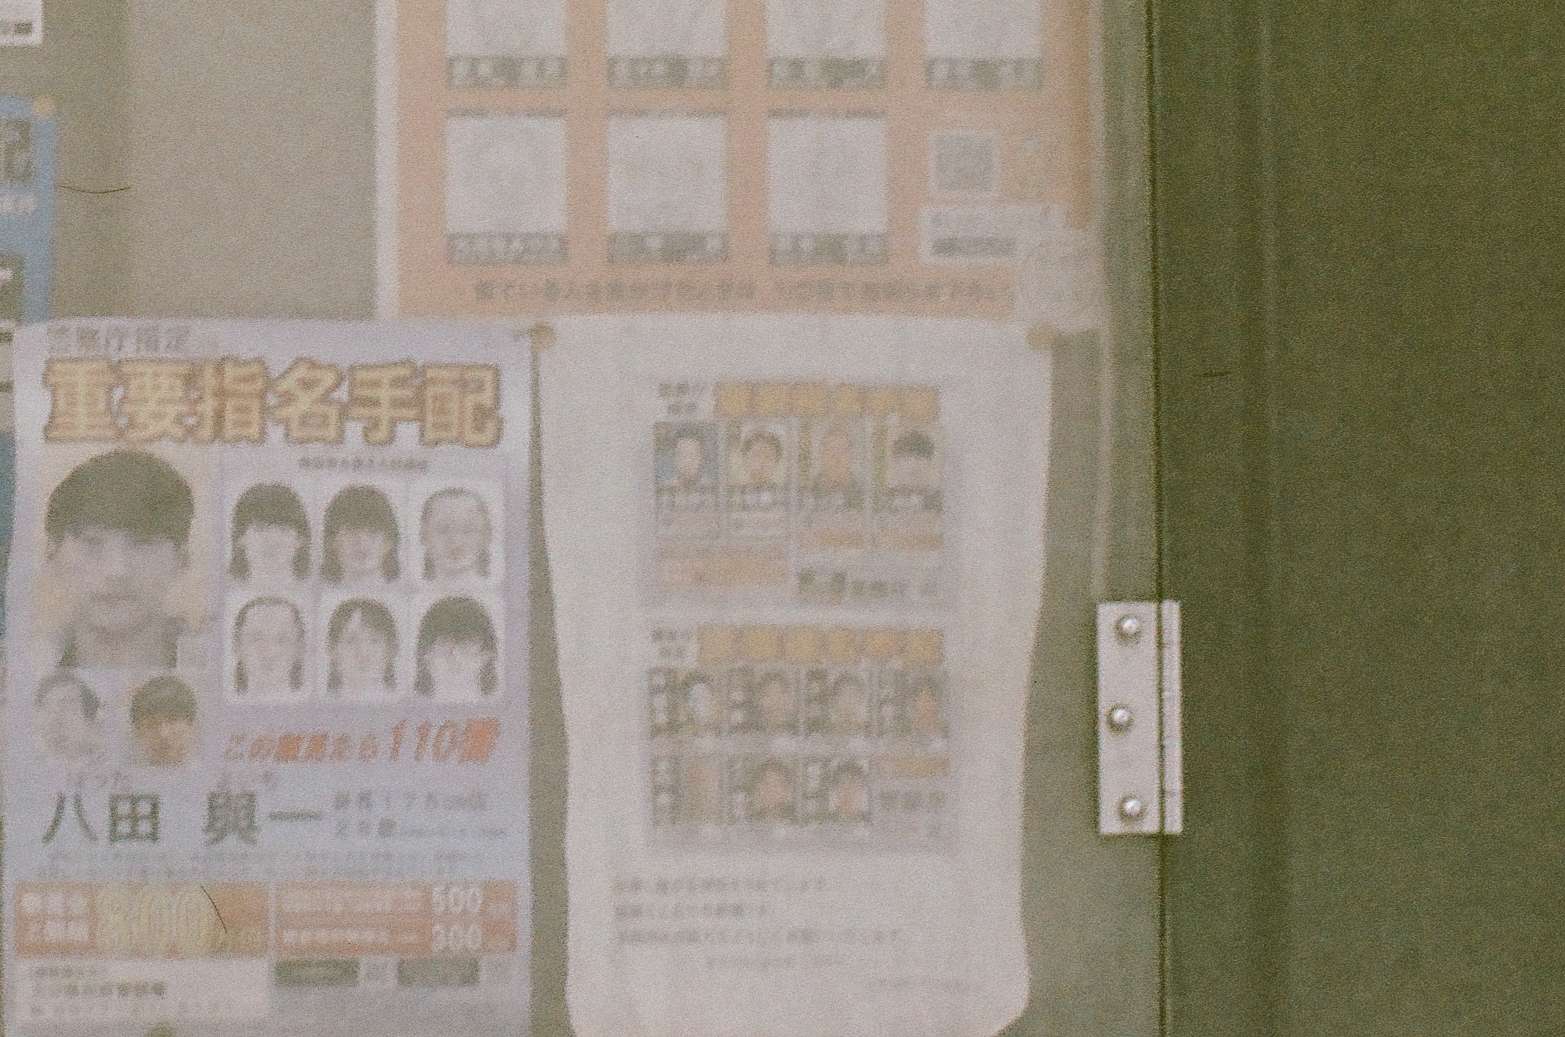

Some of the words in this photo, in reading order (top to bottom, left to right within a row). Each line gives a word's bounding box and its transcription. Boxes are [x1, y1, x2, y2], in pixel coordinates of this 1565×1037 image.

[43, 357, 503, 449] 重要指名手配
[42, 790, 161, 846] 八田
